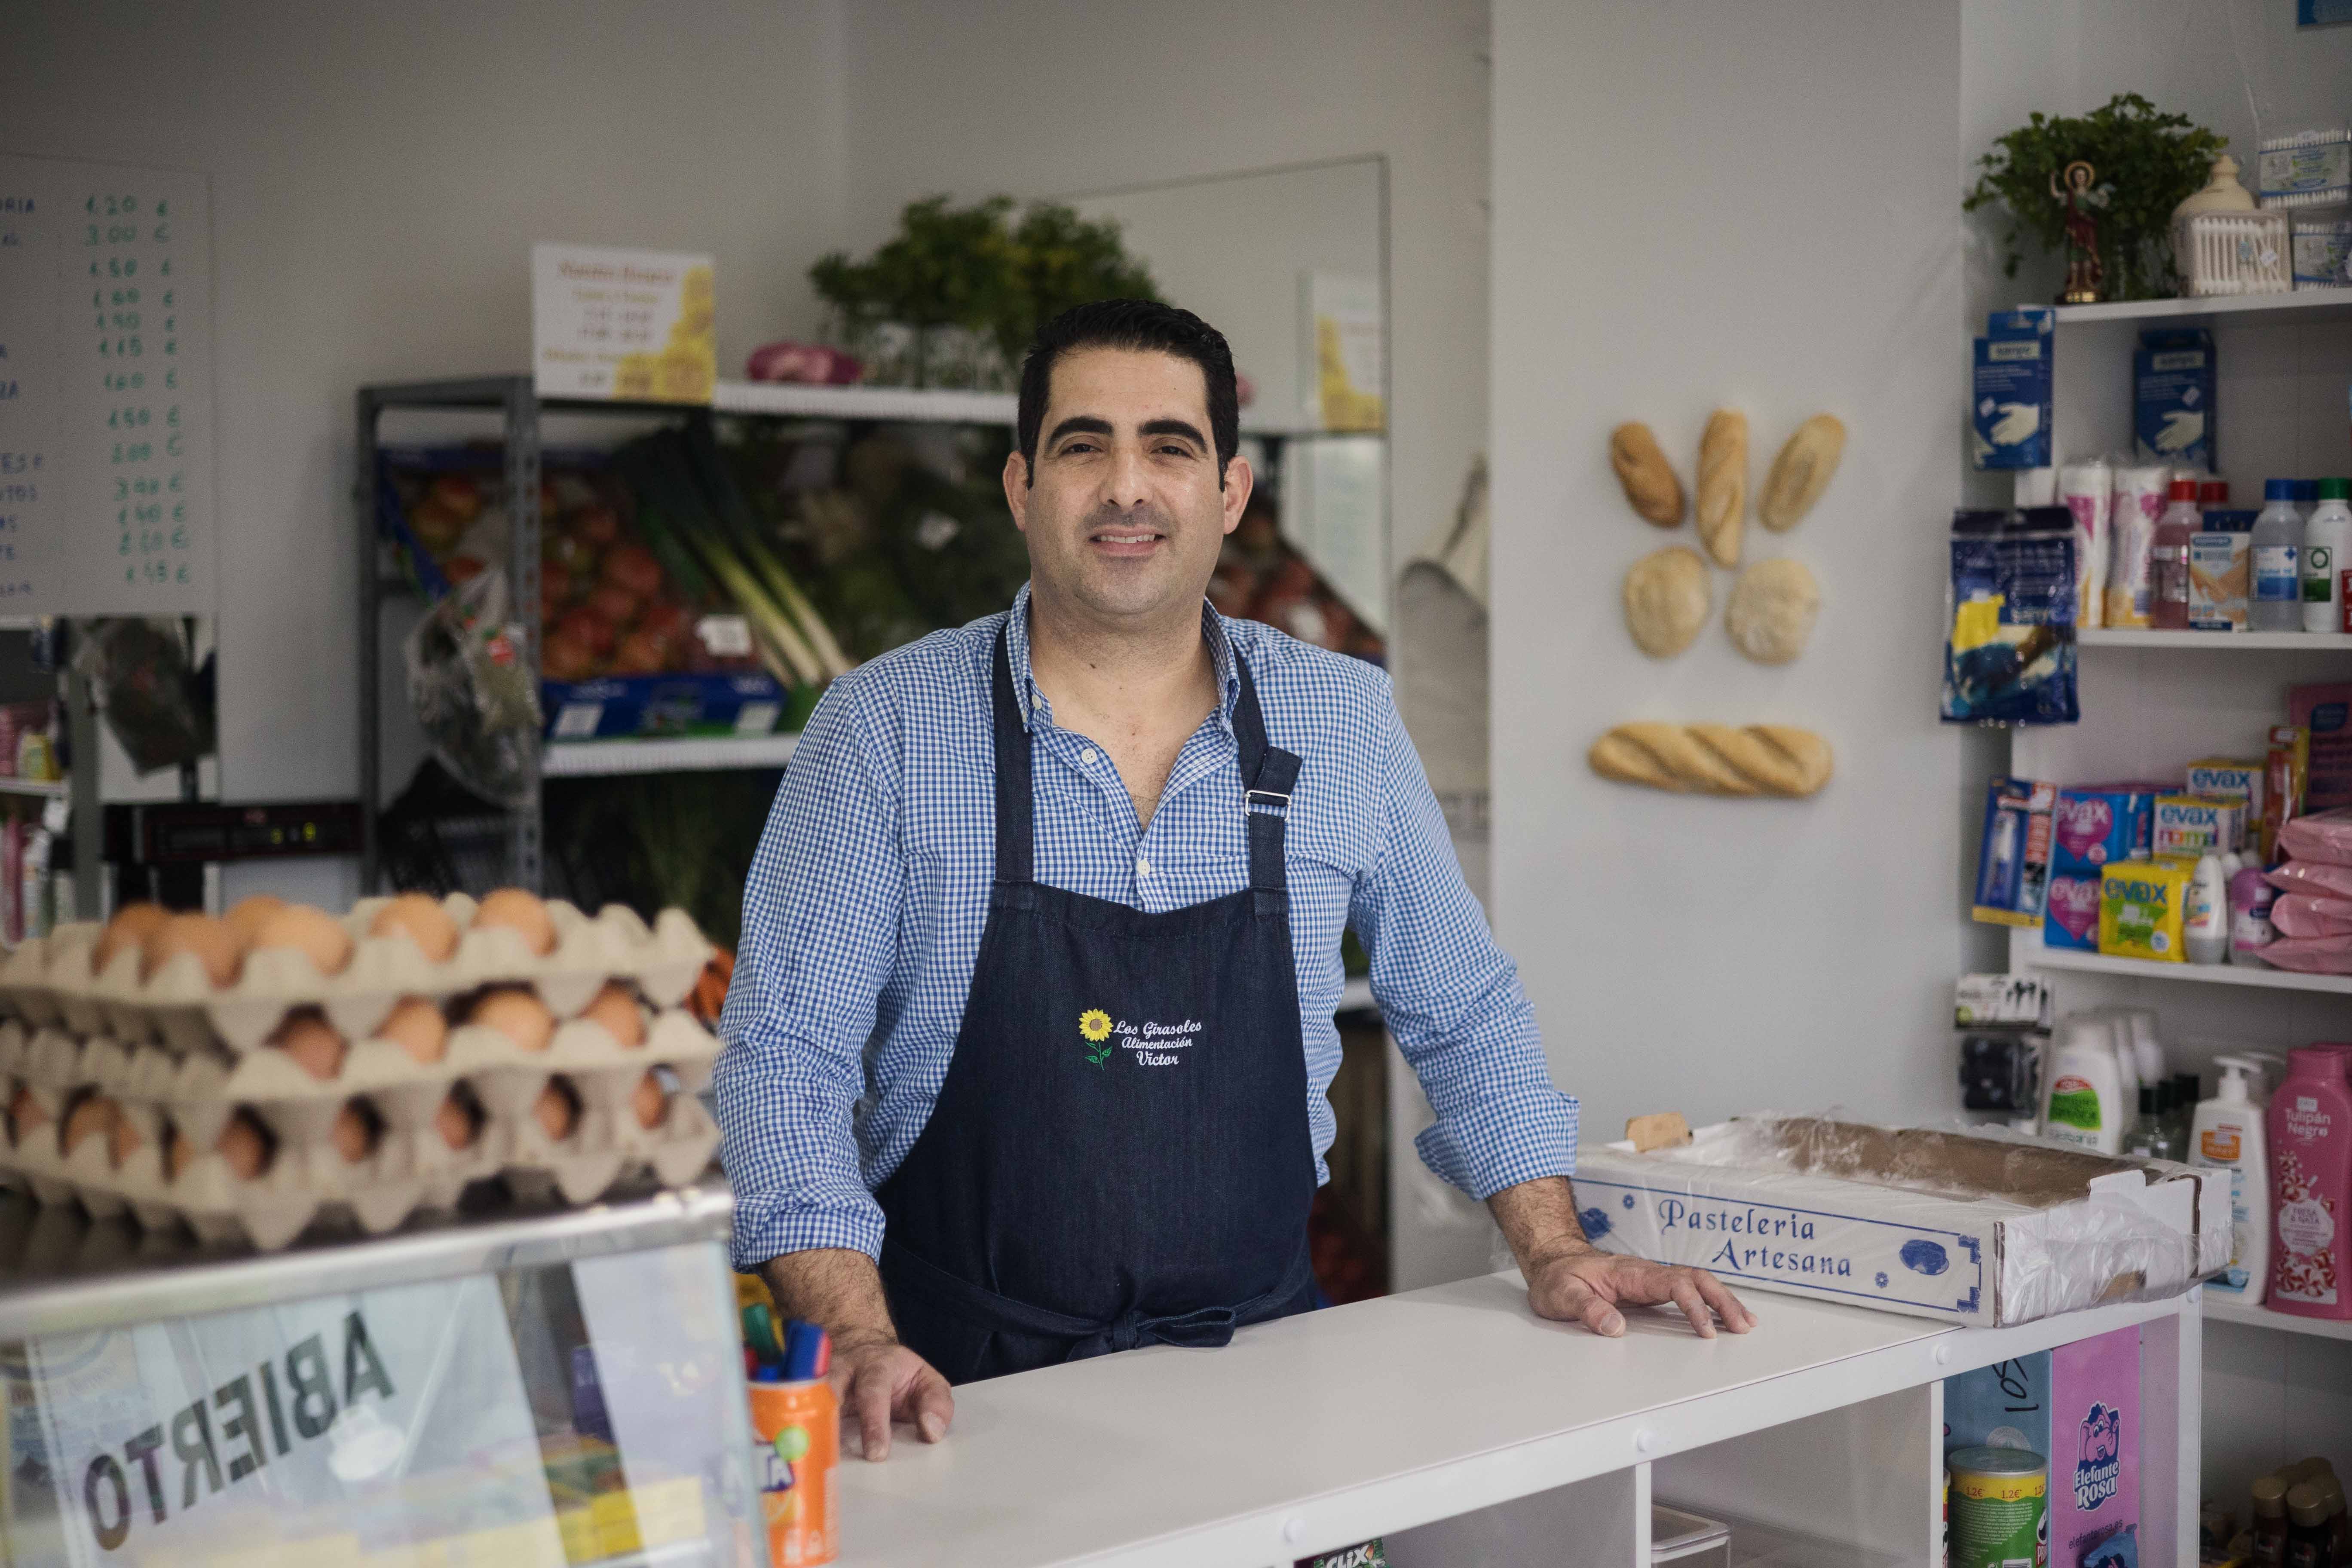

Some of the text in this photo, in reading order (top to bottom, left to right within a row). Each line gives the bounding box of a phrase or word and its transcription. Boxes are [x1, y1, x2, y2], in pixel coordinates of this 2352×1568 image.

[2193, 769, 2250, 789] evax
[2160, 805, 2218, 826] evax
[2104, 877, 2168, 903] evax
[1113, 1019, 1202, 1039] Los Girasoles
[1121, 1036, 1193, 1050] Alimentación
[2287, 1121, 2328, 1139] Negro
[1712, 1237, 1852, 1277] Artesana
[2075, 1461, 2119, 1488] Elefante
[2068, 1519, 2123, 1550] elefanterosa.es
